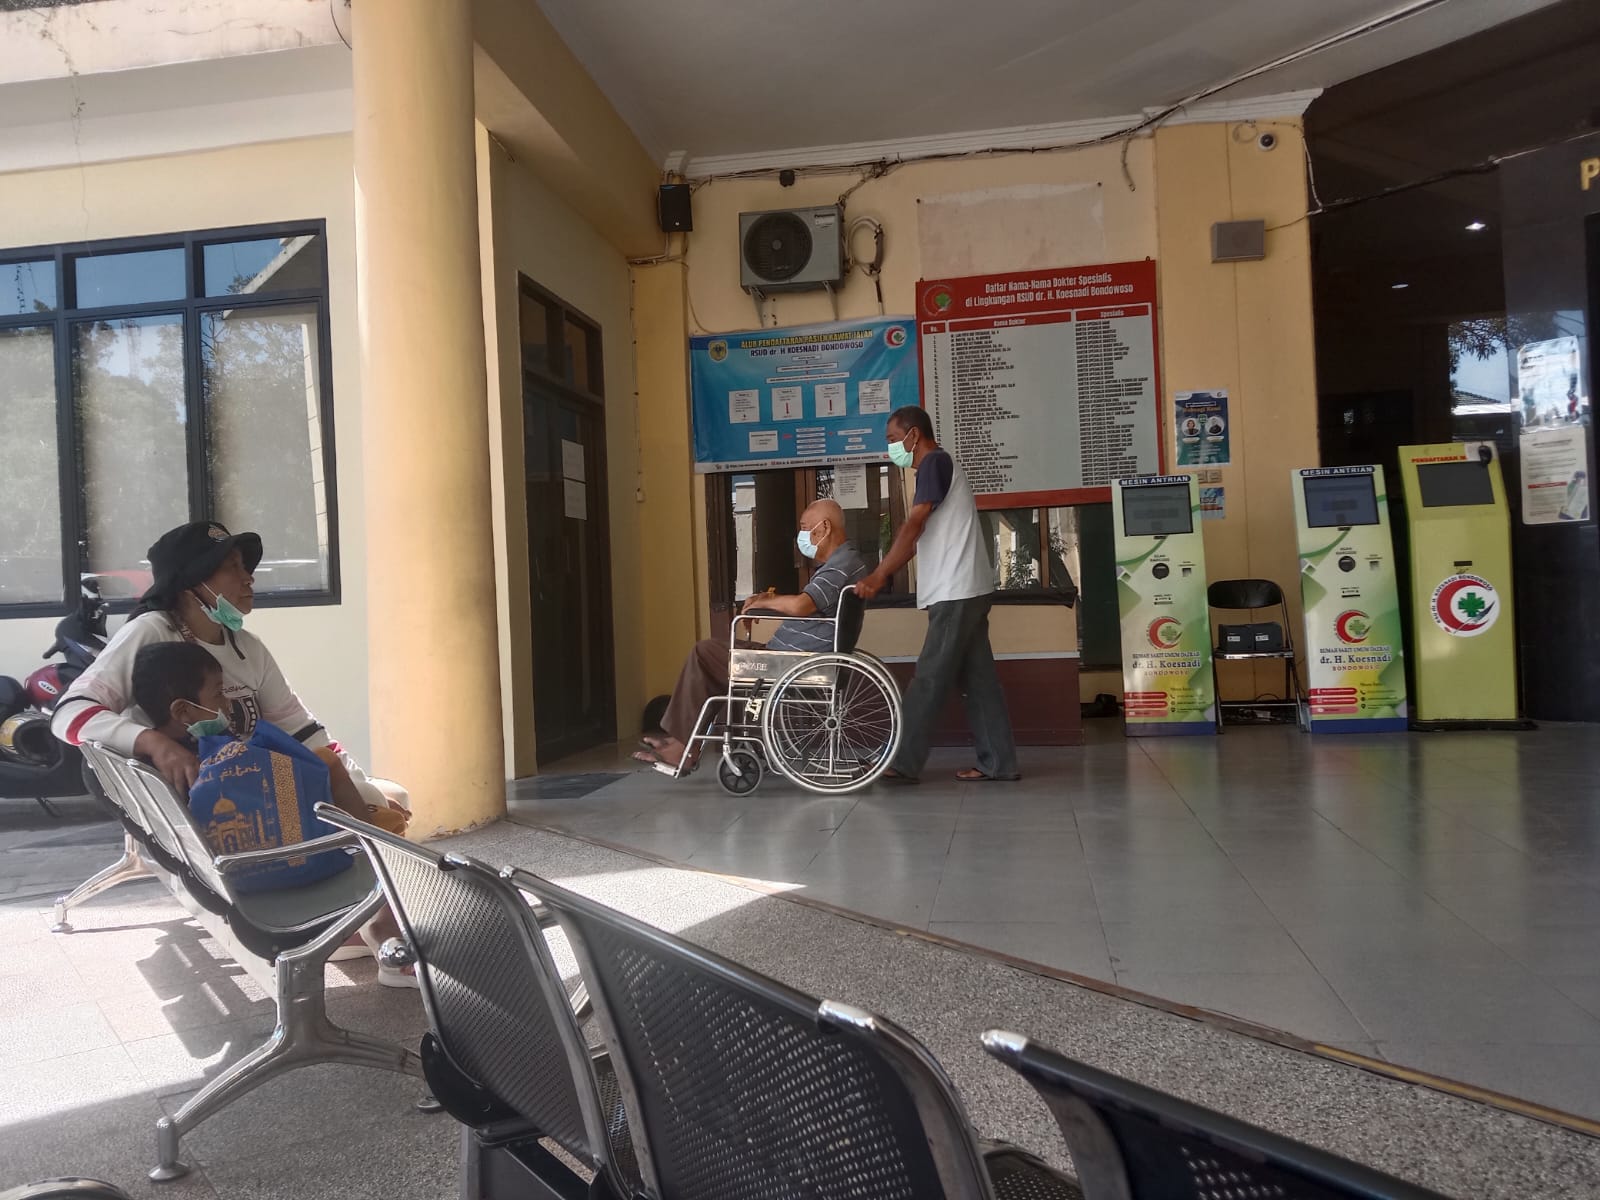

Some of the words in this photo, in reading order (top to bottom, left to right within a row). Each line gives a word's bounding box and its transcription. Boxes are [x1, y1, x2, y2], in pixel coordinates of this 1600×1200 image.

[985, 283, 1006, 293] Daftar
[1009, 279, 1051, 291] Nama-Nama
[1053, 276, 1076, 287] Dokter
[1078, 272, 1112, 286] Spesialis
[965, 297, 972, 307] di
[974, 294, 1015, 307] Lingkungan
[1017, 292, 1034, 302] RSUD
[1036, 291, 1046, 301] dr.
[1056, 286, 1089, 299] Koesnadi
[1091, 284, 1133, 296] Bondowoso
[1333, 466, 1372, 474] ANTRIAN
[1132, 660, 1144, 669] dr.
[1147, 660, 1157, 668] H.
[1160, 659, 1200, 668] Koesnadi
[1320, 656, 1332, 664] dr.
[1334, 655, 1346, 663] H.
[1348, 654, 1391, 663] Koesnadi
